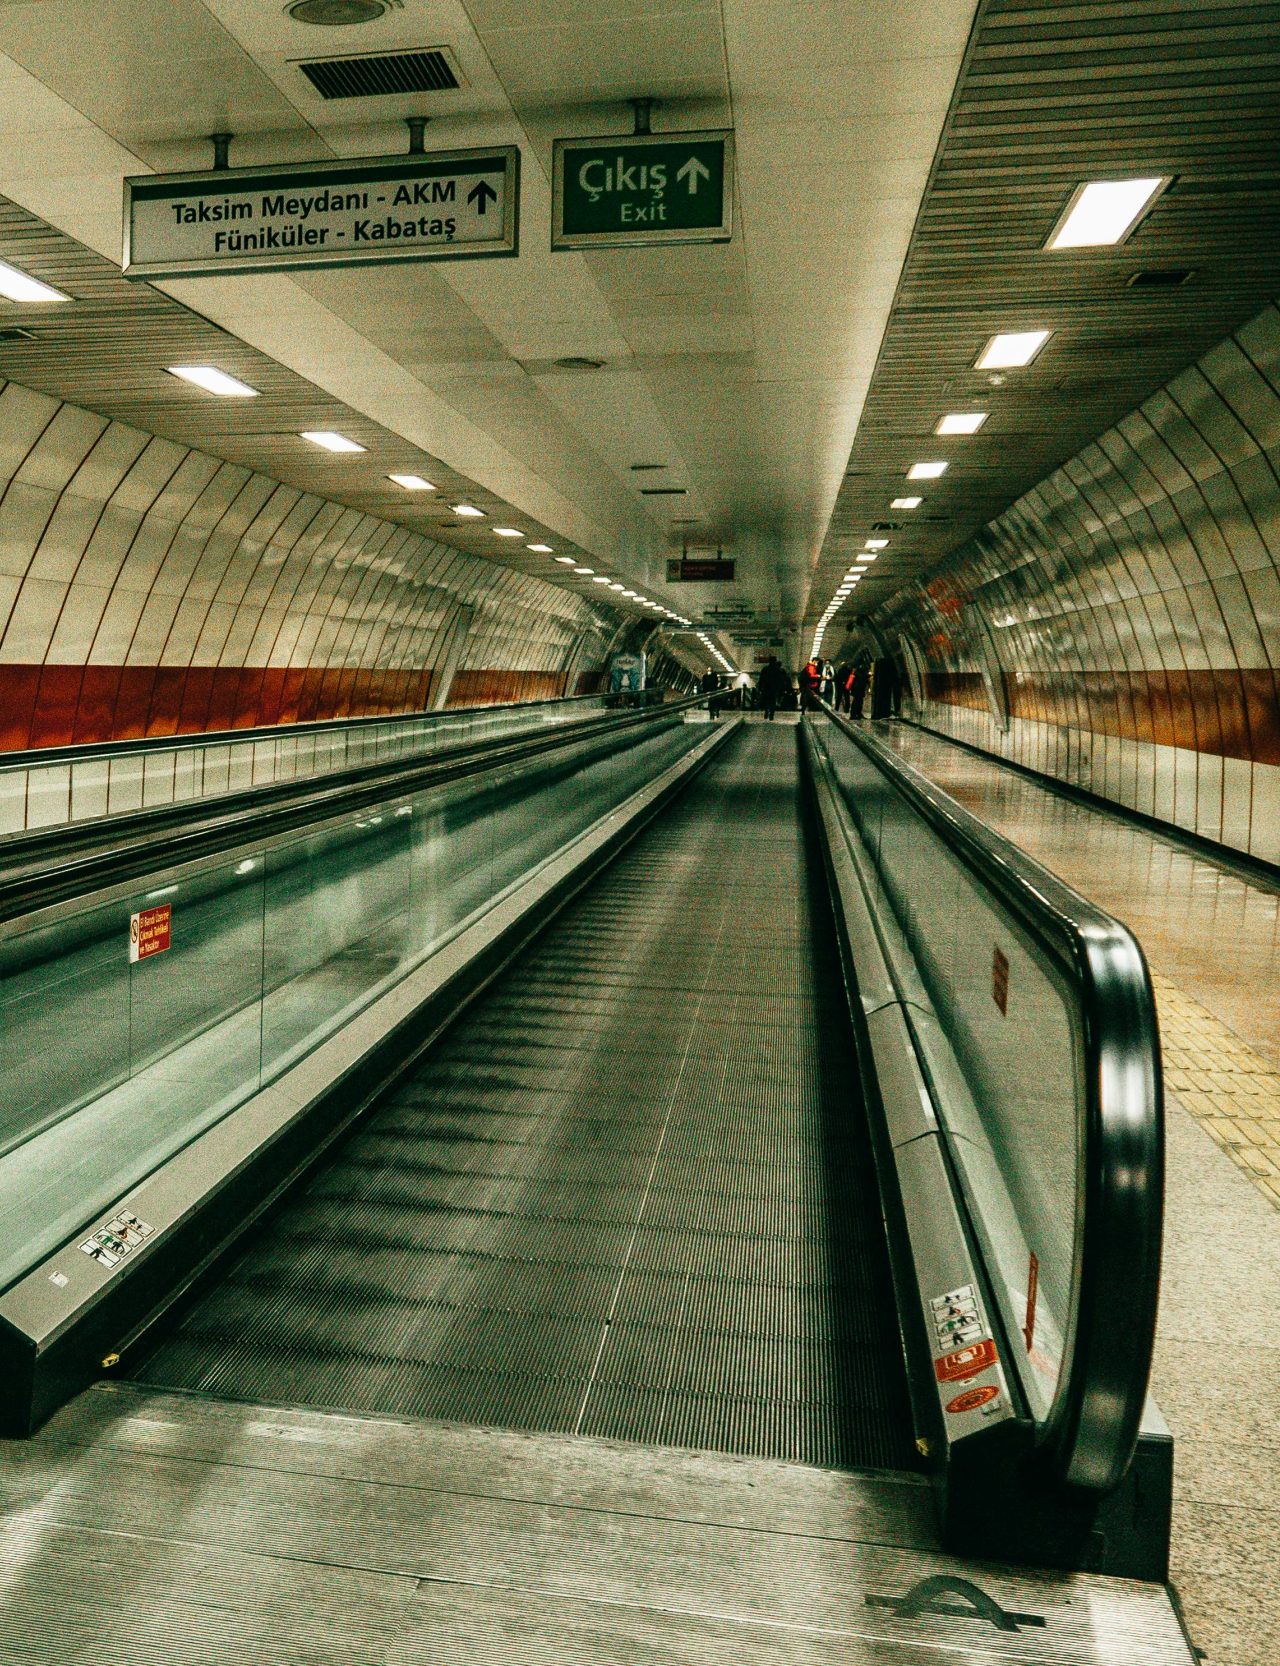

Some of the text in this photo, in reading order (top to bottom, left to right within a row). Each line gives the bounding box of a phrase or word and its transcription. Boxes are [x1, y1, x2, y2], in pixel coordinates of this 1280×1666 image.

[578, 156, 667, 202] Çıkış
[171, 199, 253, 225] Taksim
[261, 190, 369, 220] Meydanı
[392, 180, 457, 207] AKM
[620, 201, 667, 222] Exit
[214, 224, 330, 252] Füniküler
[353, 216, 457, 241] Kabataş
